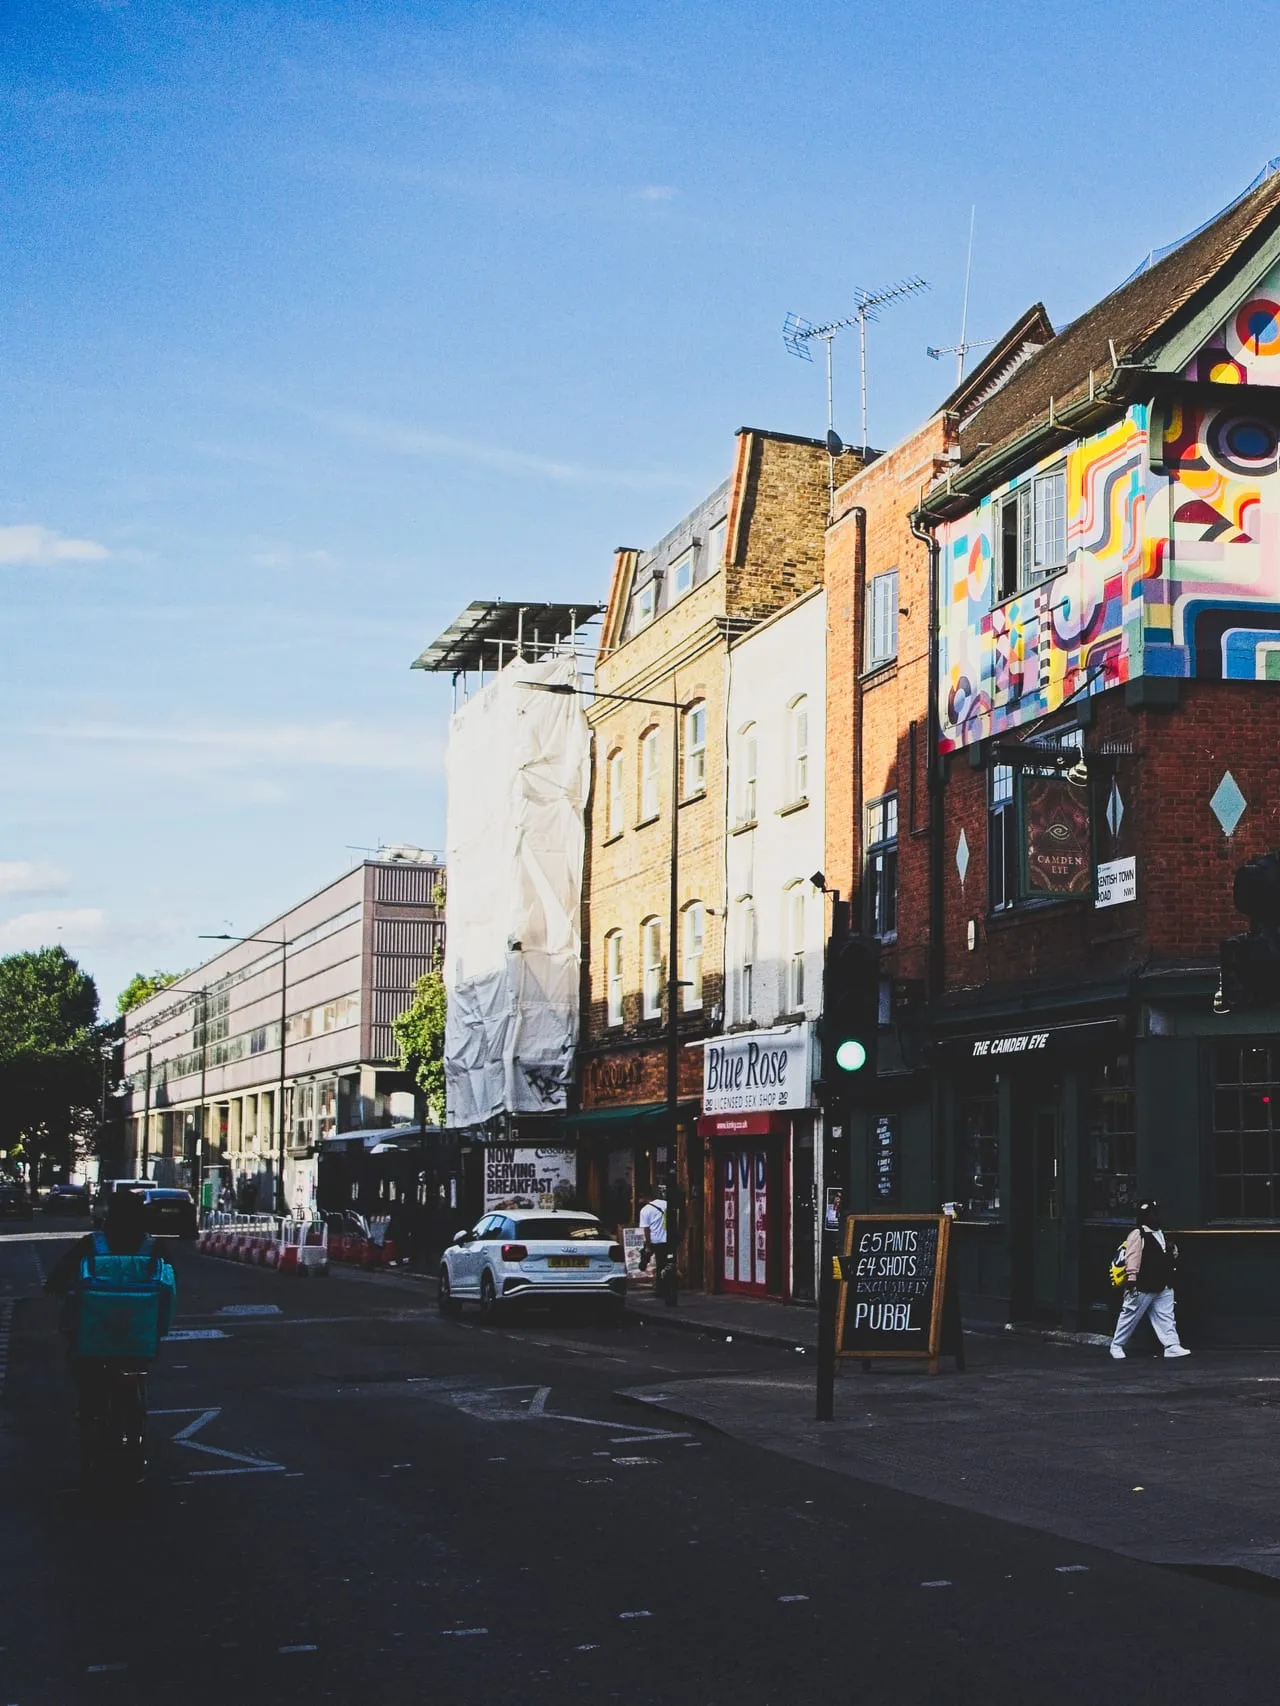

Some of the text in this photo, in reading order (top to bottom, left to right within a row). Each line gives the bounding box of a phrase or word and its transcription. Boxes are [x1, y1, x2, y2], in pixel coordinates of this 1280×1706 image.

[1037, 855, 1083, 865] CAMDEN
[1051, 866, 1069, 874] EYE
[1098, 869, 1134, 888] ENTISH TOWN
[972, 1033, 1050, 1056] THE CAMDEN EYE
[707, 1042, 788, 1091] Blue Rose
[745, 1095, 757, 1108] SEX
[759, 1093, 776, 1106] SHOP
[487, 1148, 515, 1163] NOW
[487, 1163, 536, 1178] SERVING
[724, 1152, 767, 1190] DVD
[487, 1178, 553, 1194] BREAKFAST
[859, 1230, 918, 1253] £5 PINTS
[856, 1256, 917, 1277] £4 SHOTS
[856, 1281, 928, 1296] EXCLUSIVELY
[855, 1303, 922, 1331] PUBBL
